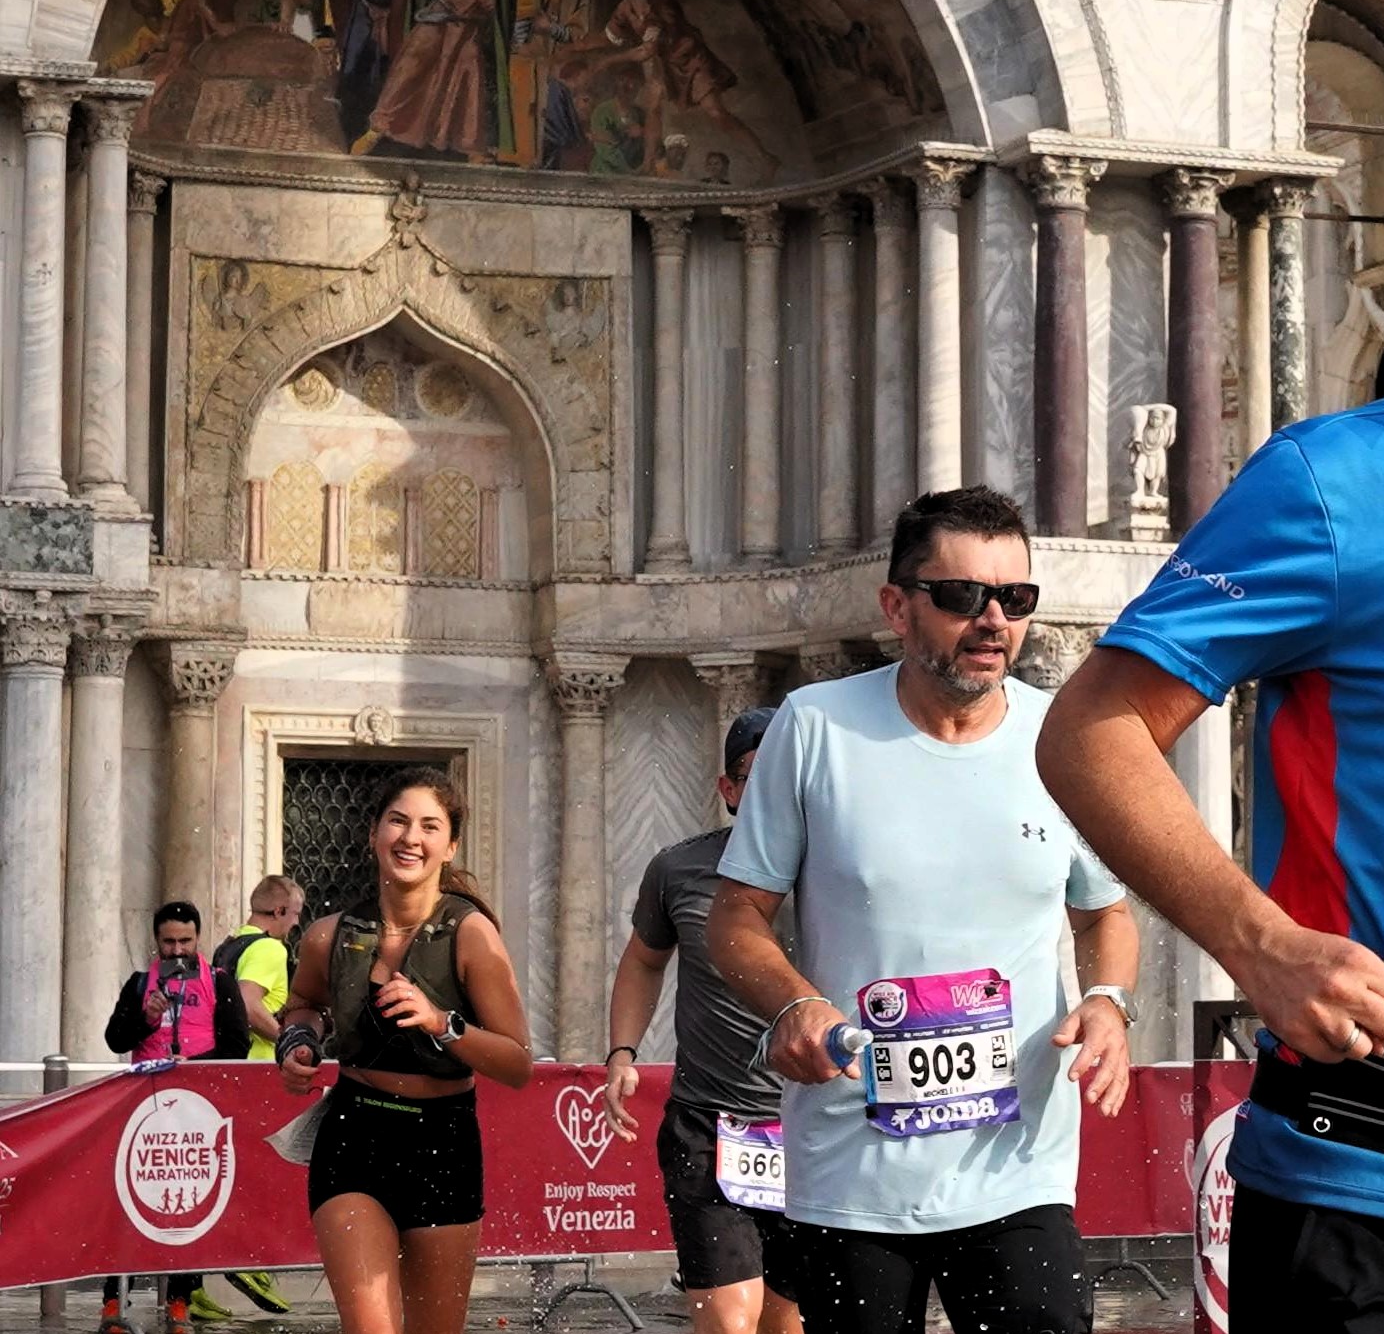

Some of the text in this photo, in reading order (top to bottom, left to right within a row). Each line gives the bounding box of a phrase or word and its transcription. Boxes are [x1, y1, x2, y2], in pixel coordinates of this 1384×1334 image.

[908, 1042, 976, 1088] 903
[142, 1132, 204, 1146] WIZZ AIR
[137, 1148, 210, 1167] VENICE
[136, 1168, 210, 1182] MARATHON
[544, 1181, 637, 1202] Enjoy Respect
[543, 1202, 636, 1232] Venezia
